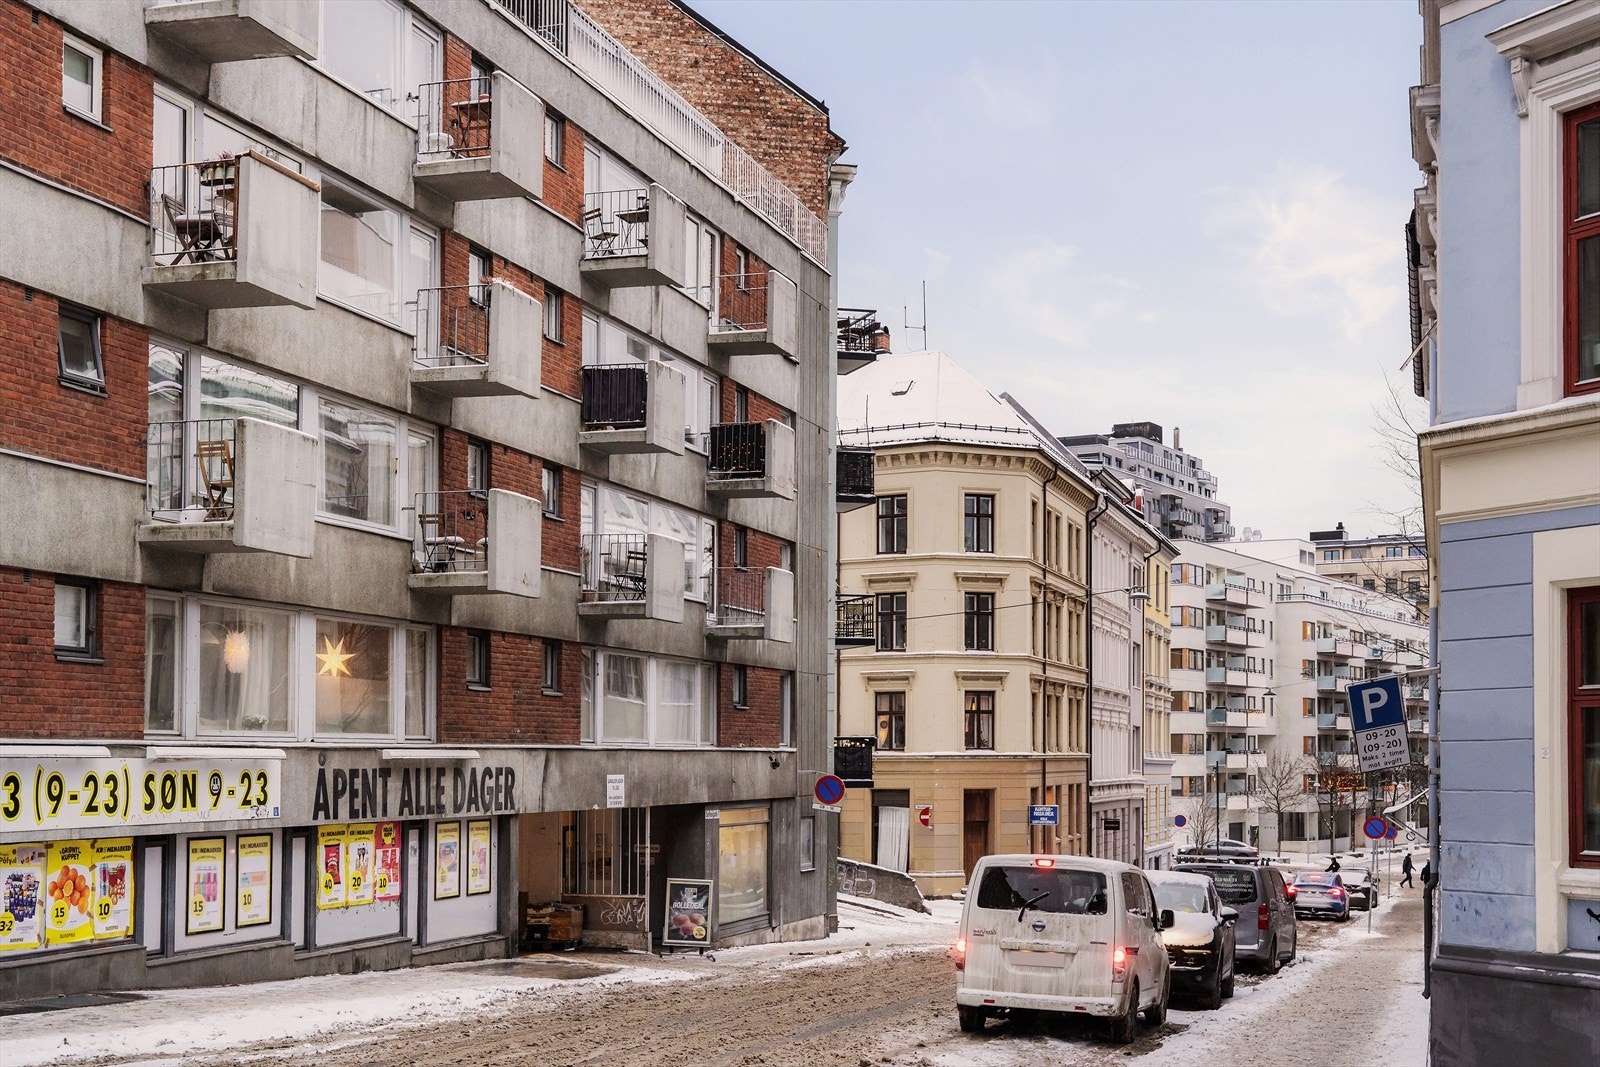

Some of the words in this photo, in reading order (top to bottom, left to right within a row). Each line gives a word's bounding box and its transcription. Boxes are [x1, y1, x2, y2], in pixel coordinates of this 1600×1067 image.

[1361, 687, 1389, 724] P
[1362, 752, 1379, 762] Maks
[1389, 749, 1406, 757] timer
[1368, 761, 1381, 769] mot
[1383, 757, 1403, 767] avgift
[142, 770, 199, 814] SØN
[312, 752, 391, 820] ÅPENT
[398, 766, 446, 817] ALLE
[452, 766, 516, 814] DAGER
[324, 879, 333, 890] 40
[352, 876, 361, 887] 20
[379, 878, 387, 888] 10
[243, 894, 252, 905] 10
[672, 901, 705, 910] BOLLEDEAL
[54, 907, 65, 918] 15
[98, 903, 110, 916] 10
[193, 901, 204, 913] 15
